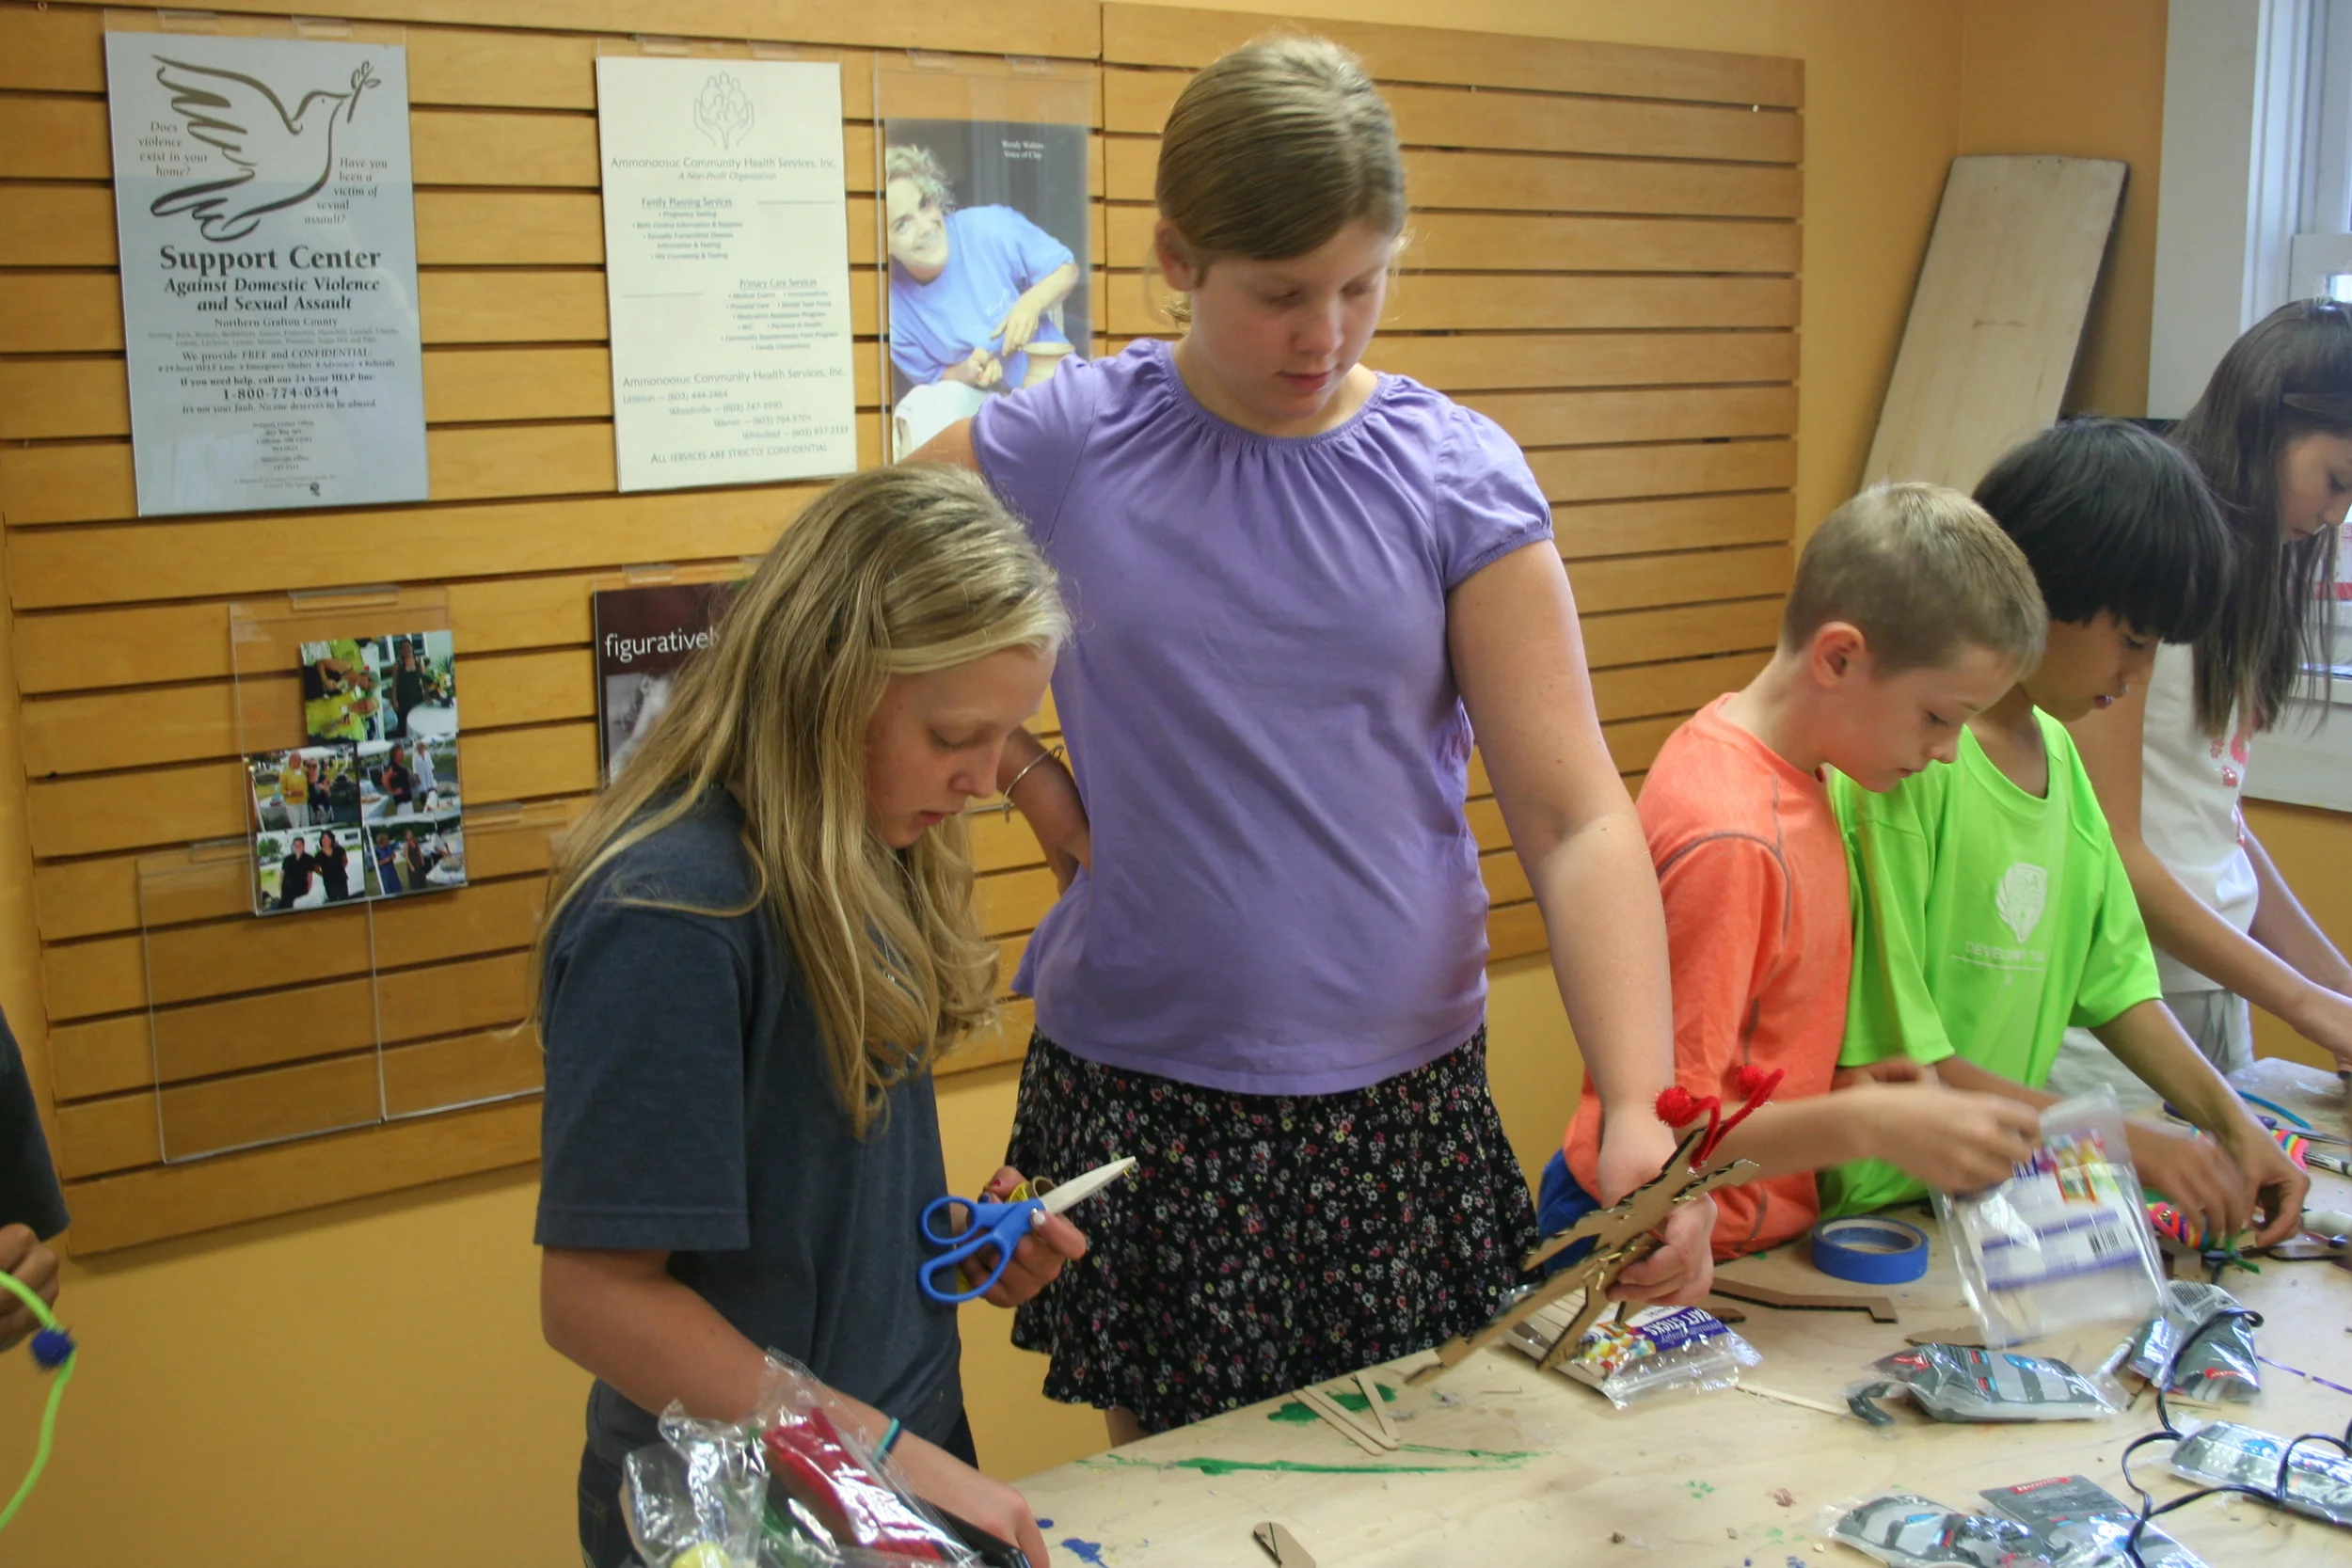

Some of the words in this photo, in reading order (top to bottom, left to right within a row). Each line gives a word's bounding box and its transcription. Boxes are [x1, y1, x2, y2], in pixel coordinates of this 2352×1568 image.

[138, 135, 183, 148] violence
[139, 150, 165, 162] exist
[169, 150, 180, 162] in
[612, 156, 682, 168] Ammonoosuc
[683, 155, 740, 170] Community
[743, 156, 775, 168] Health
[156, 164, 191, 176] home?
[339, 157, 365, 168] Have
[369, 160, 388, 170] you
[339, 170, 362, 182] been
[333, 185, 364, 196] victim
[367, 184, 378, 199] of
[316, 198, 350, 210] sexual
[641, 196, 666, 209] Family
[669, 196, 701, 209] Planning
[702, 196, 733, 209] Services
[304, 213, 346, 225] assault?
[160, 244, 279, 277] Support
[289, 244, 382, 270] Center
[164, 277, 228, 298] Against
[234, 277, 308, 293] Domestic
[312, 275, 380, 292] Violence
[788, 277, 817, 289] Services
[197, 294, 229, 312] and
[234, 294, 288, 312] Sexual
[294, 293, 352, 310] Assault
[214, 316, 260, 328] Northern
[262, 316, 300, 328] Grafton
[303, 316, 339, 328] County
[182, 350, 197, 361] We
[201, 349, 238, 363] provide
[242, 349, 266, 360] FREE
[270, 348, 289, 359] and
[189, 378, 208, 390] you
[210, 375, 231, 386] need
[258, 374, 275, 385] call
[277, 375, 292, 384] our
[331, 372, 356, 382] HELP
[622, 375, 691, 388] Ammonoosuc
[692, 370, 751, 384] Community
[753, 369, 785, 381] Health
[622, 393, 656, 404] Littleton
[667, 391, 689, 403] (603)
[196, 404, 211, 414] not
[213, 404, 231, 416] your
[290, 401, 324, 411] deserves
[326, 401, 335, 409] to
[336, 399, 345, 408] be
